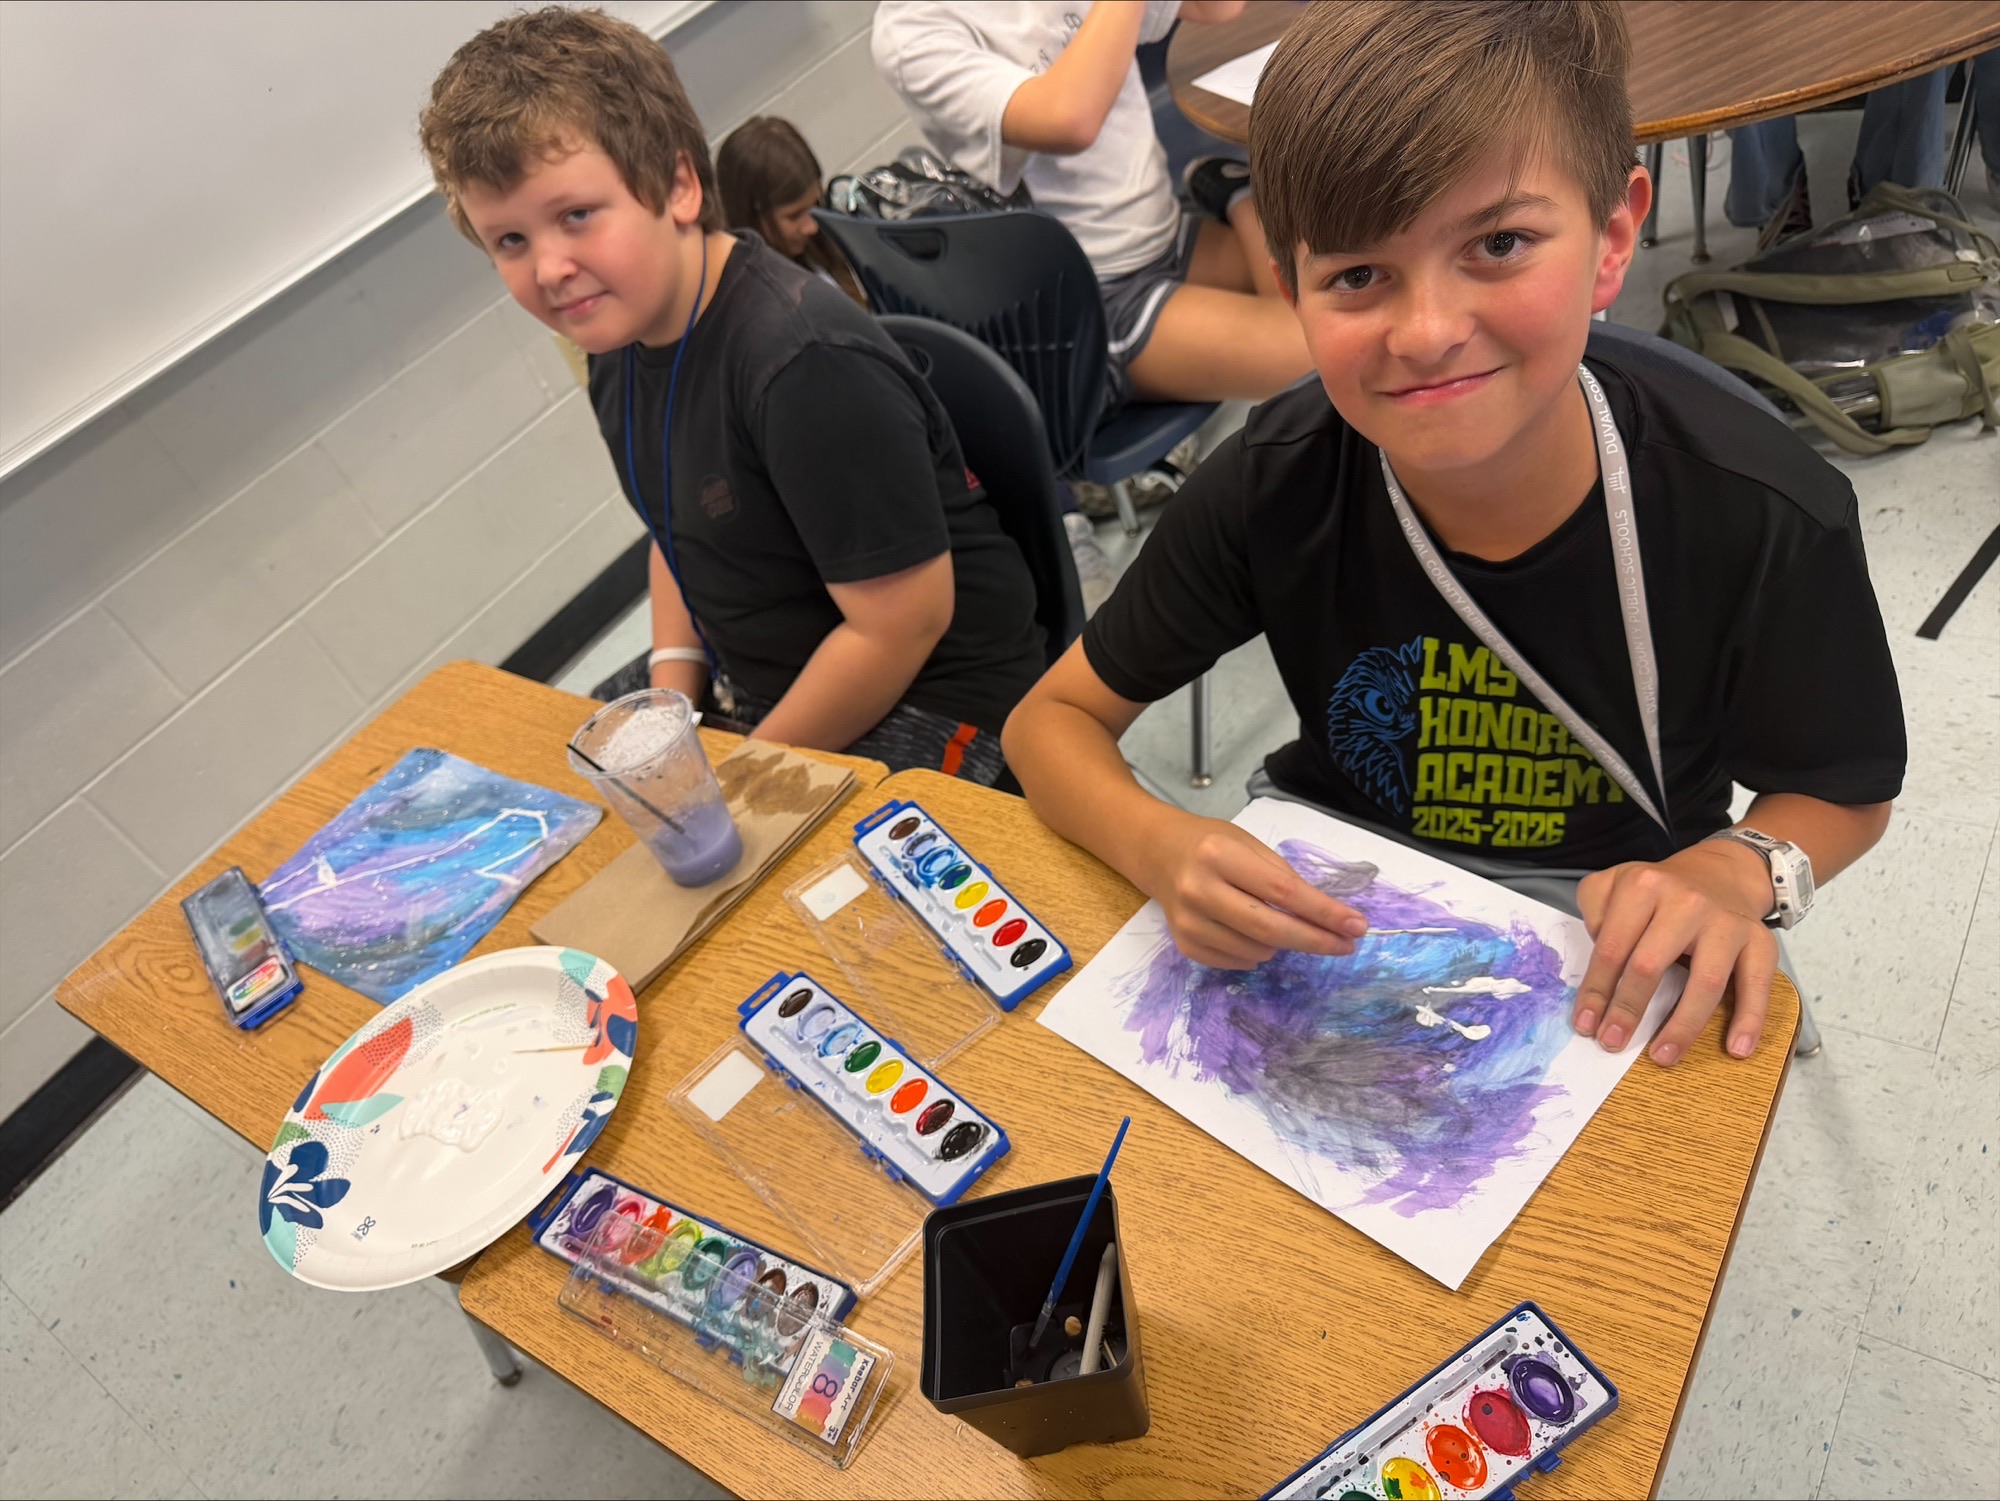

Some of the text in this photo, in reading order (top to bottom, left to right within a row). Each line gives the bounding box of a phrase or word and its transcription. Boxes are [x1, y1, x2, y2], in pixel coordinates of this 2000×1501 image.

[1577, 363, 1619, 455] DUVAL COUN
[1614, 509, 1635, 574] SCHOOLS
[1401, 517, 1429, 559] DUVAL
[1426, 559, 1466, 606] COUNTY
[1460, 605, 1496, 643] PUBLIC
[1623, 577, 1640, 623] PUBLIC
[1419, 636, 1518, 697] LMS
[1631, 627, 1650, 676] COUNTY
[1411, 805, 1566, 848] 2025-2026
[784, 1341, 824, 1411] WATERCOLOR
[812, 1373, 838, 1398] 8
[840, 1395, 853, 1411] Art
